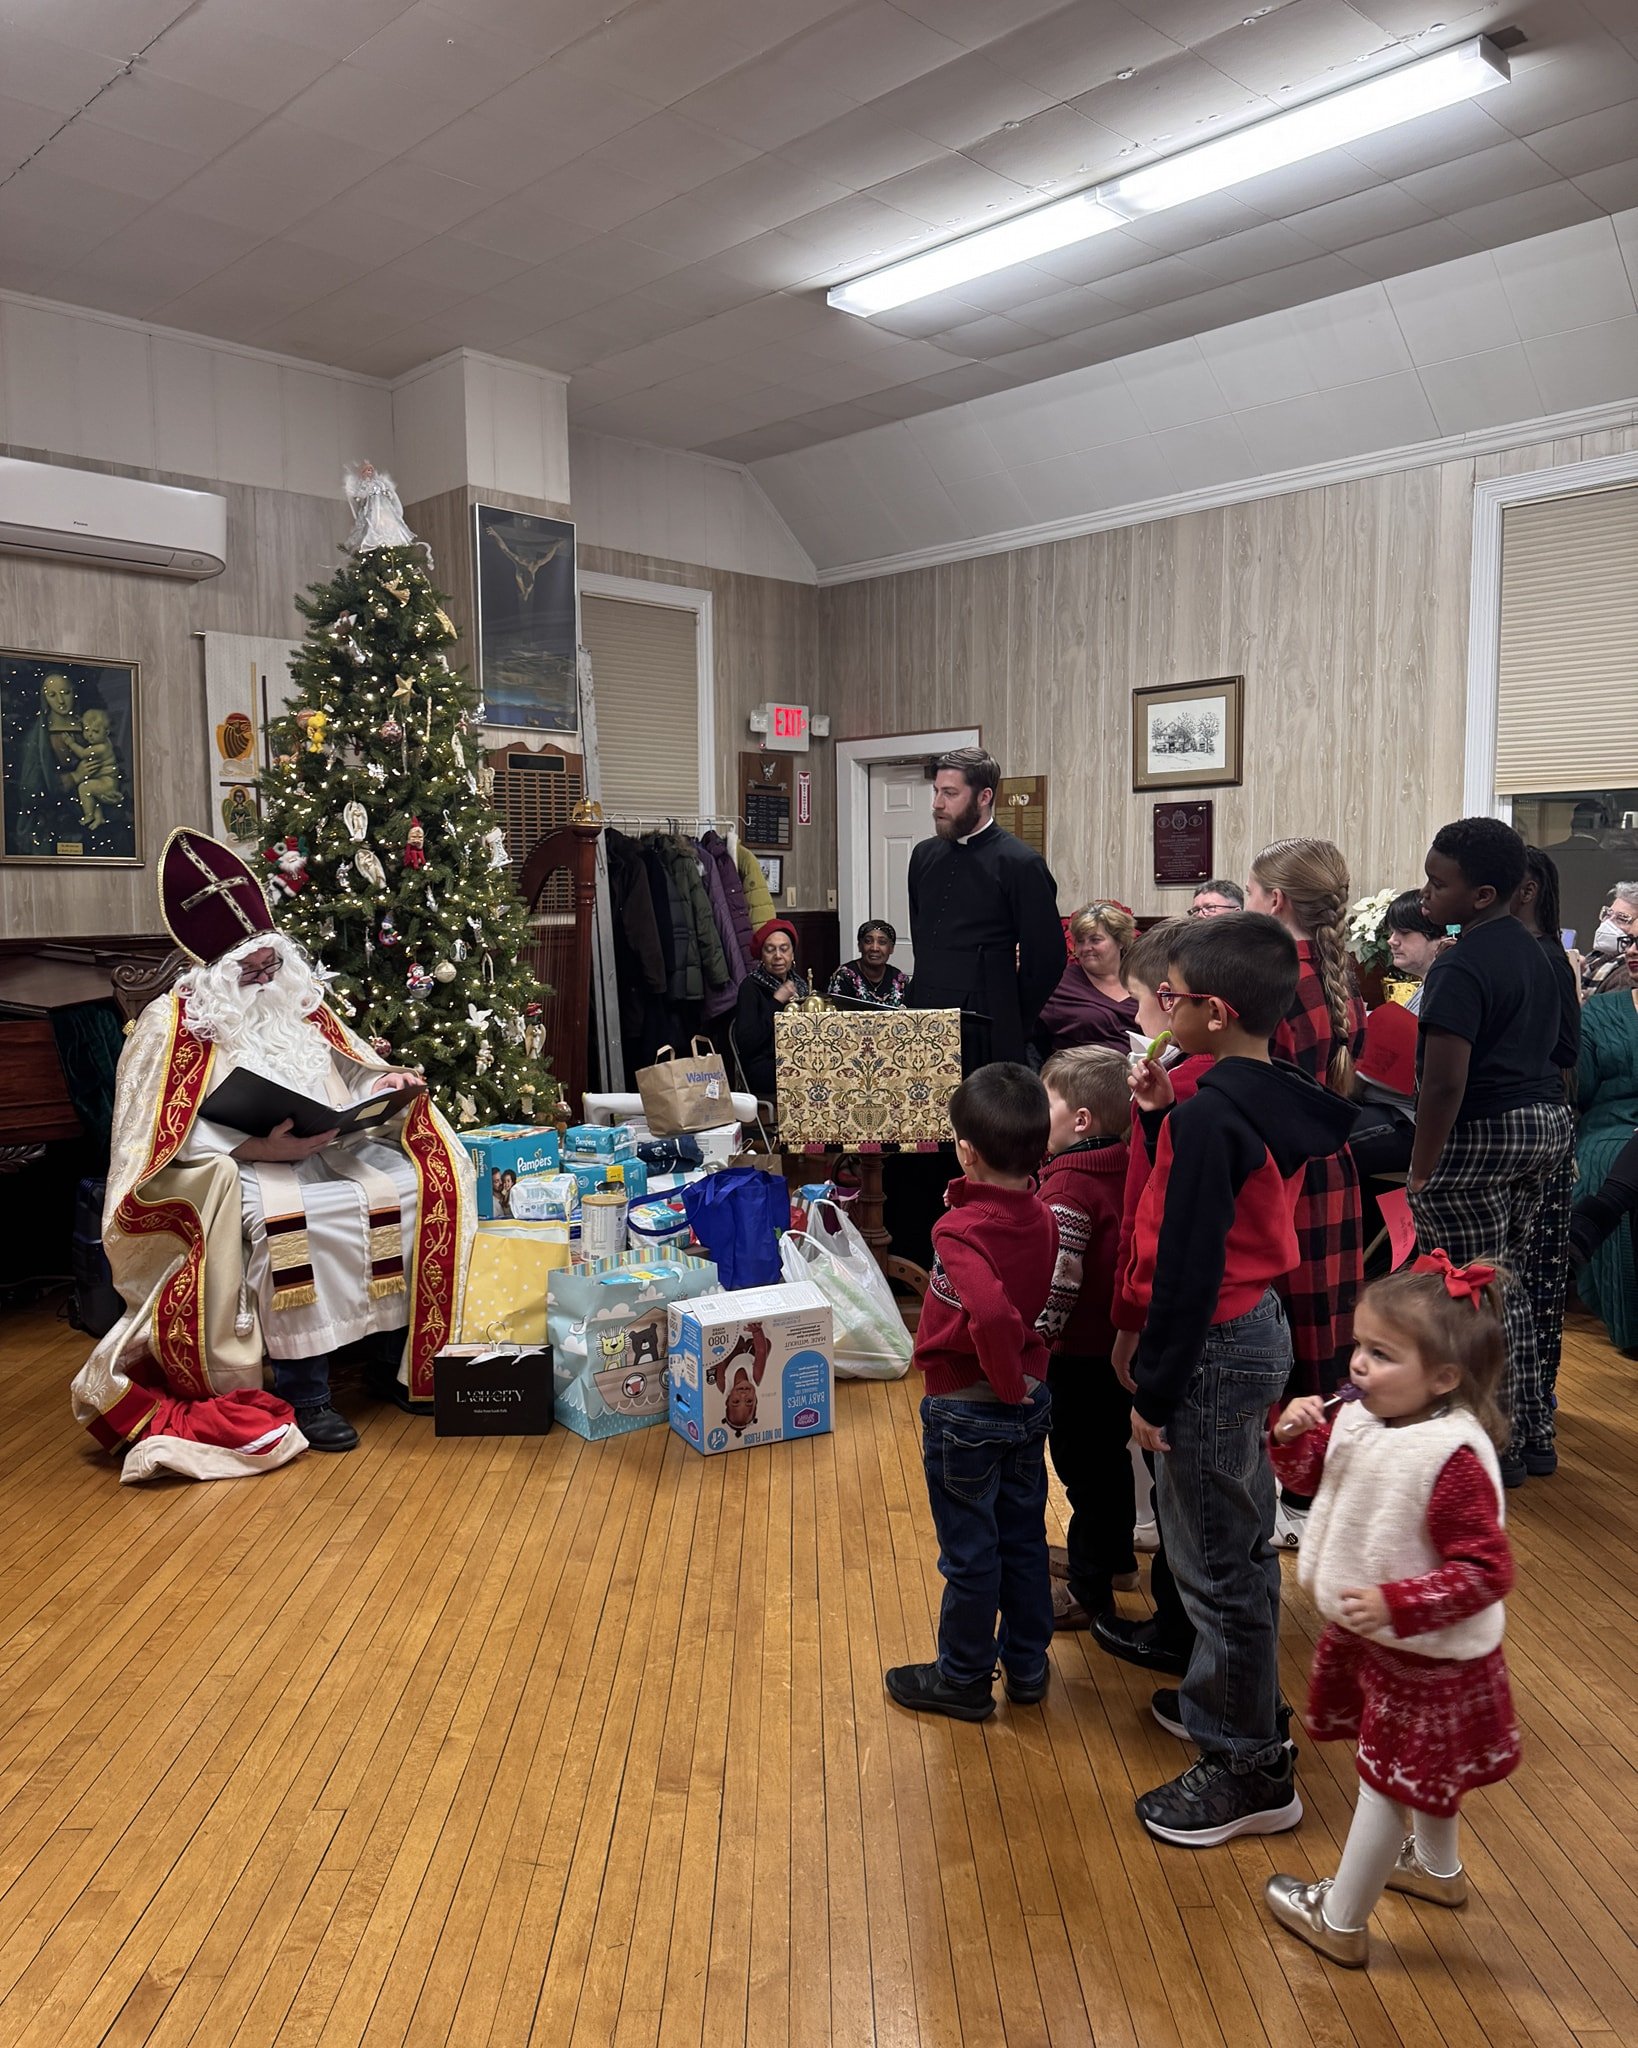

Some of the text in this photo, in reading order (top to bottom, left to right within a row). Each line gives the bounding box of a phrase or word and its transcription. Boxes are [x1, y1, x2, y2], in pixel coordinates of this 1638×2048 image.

[775, 707, 802, 737] EXIT
[686, 1072, 721, 1083] Walm
[517, 1156, 552, 1174] Pampers
[708, 1334, 729, 1347] 1080
[787, 1395, 807, 1408] WIPES
[808, 1391, 825, 1405] BABY
